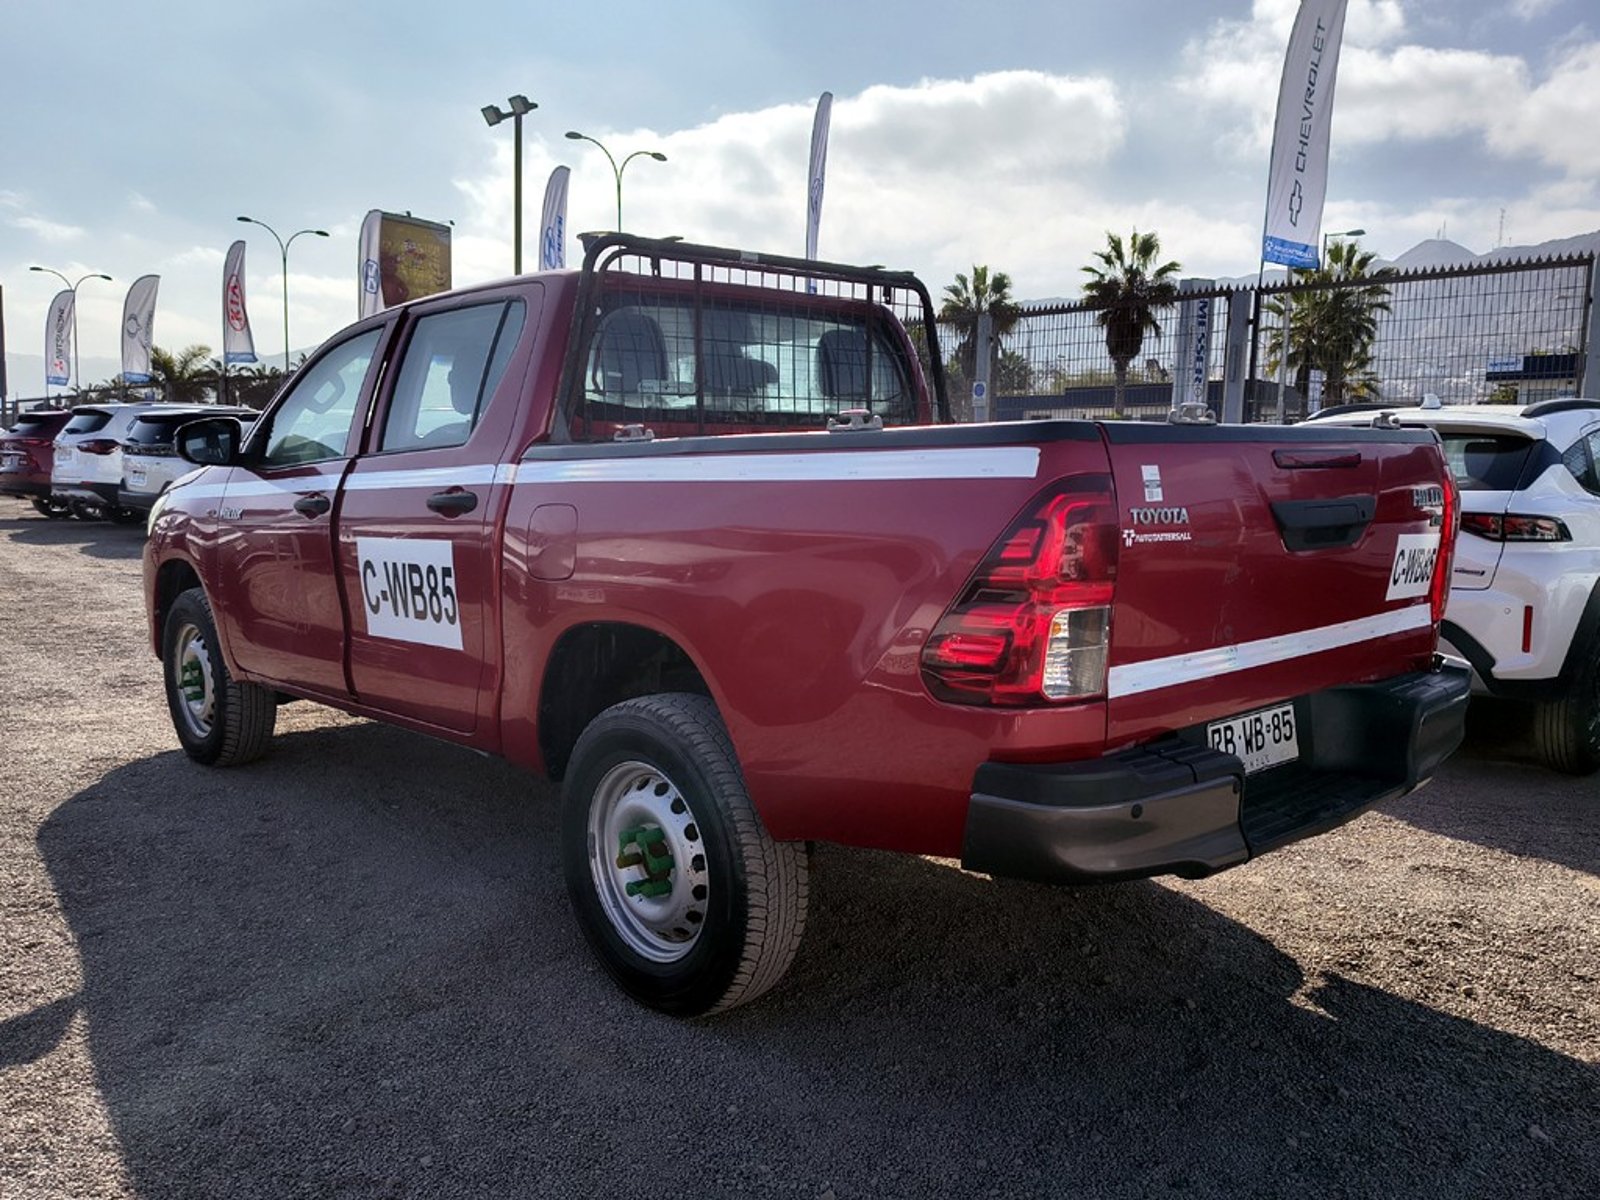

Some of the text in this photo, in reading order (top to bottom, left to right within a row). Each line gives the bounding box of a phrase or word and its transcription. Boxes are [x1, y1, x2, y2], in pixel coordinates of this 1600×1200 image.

[1294, 18, 1328, 173] CHEVROLET
[228, 284, 242, 321] KIA
[1129, 507, 1190, 525] TOYOTA
[362, 559, 457, 626] C-WB85
